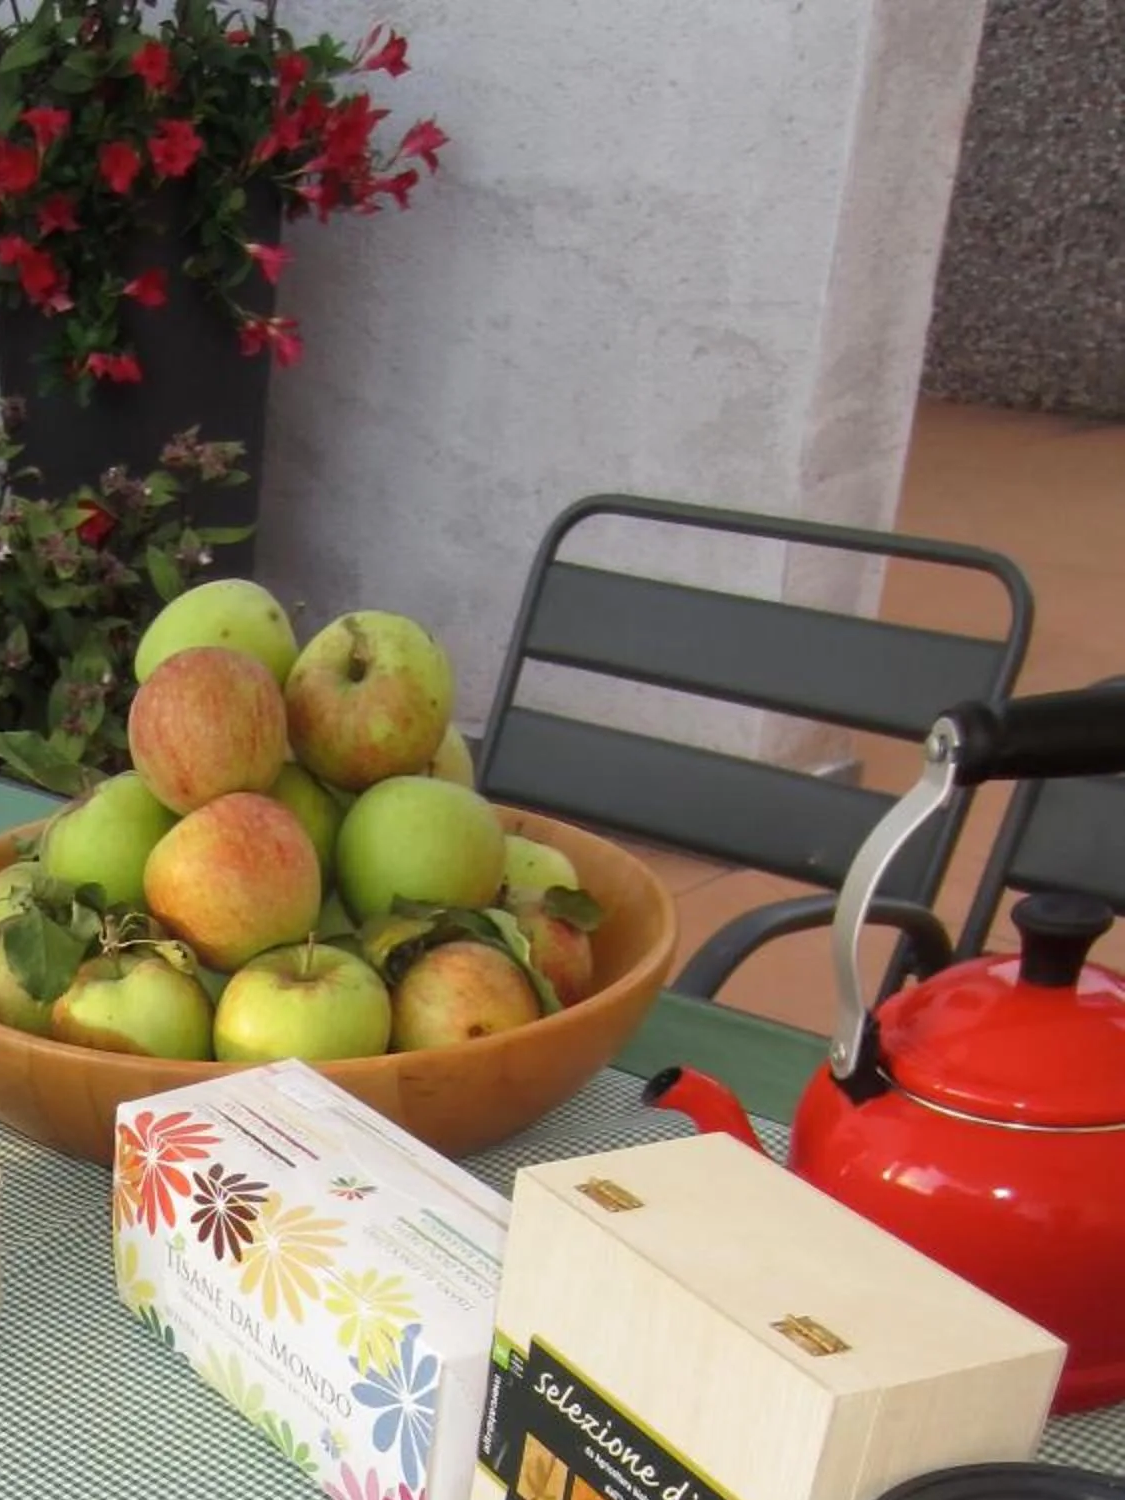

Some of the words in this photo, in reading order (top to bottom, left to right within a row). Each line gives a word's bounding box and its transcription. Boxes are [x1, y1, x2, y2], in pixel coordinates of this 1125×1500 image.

[165, 1240, 225, 1312] TISANE
[230, 1300, 264, 1347] DAL
[270, 1333, 353, 1418] MONDO
[534, 1372, 660, 1487] Selezione
